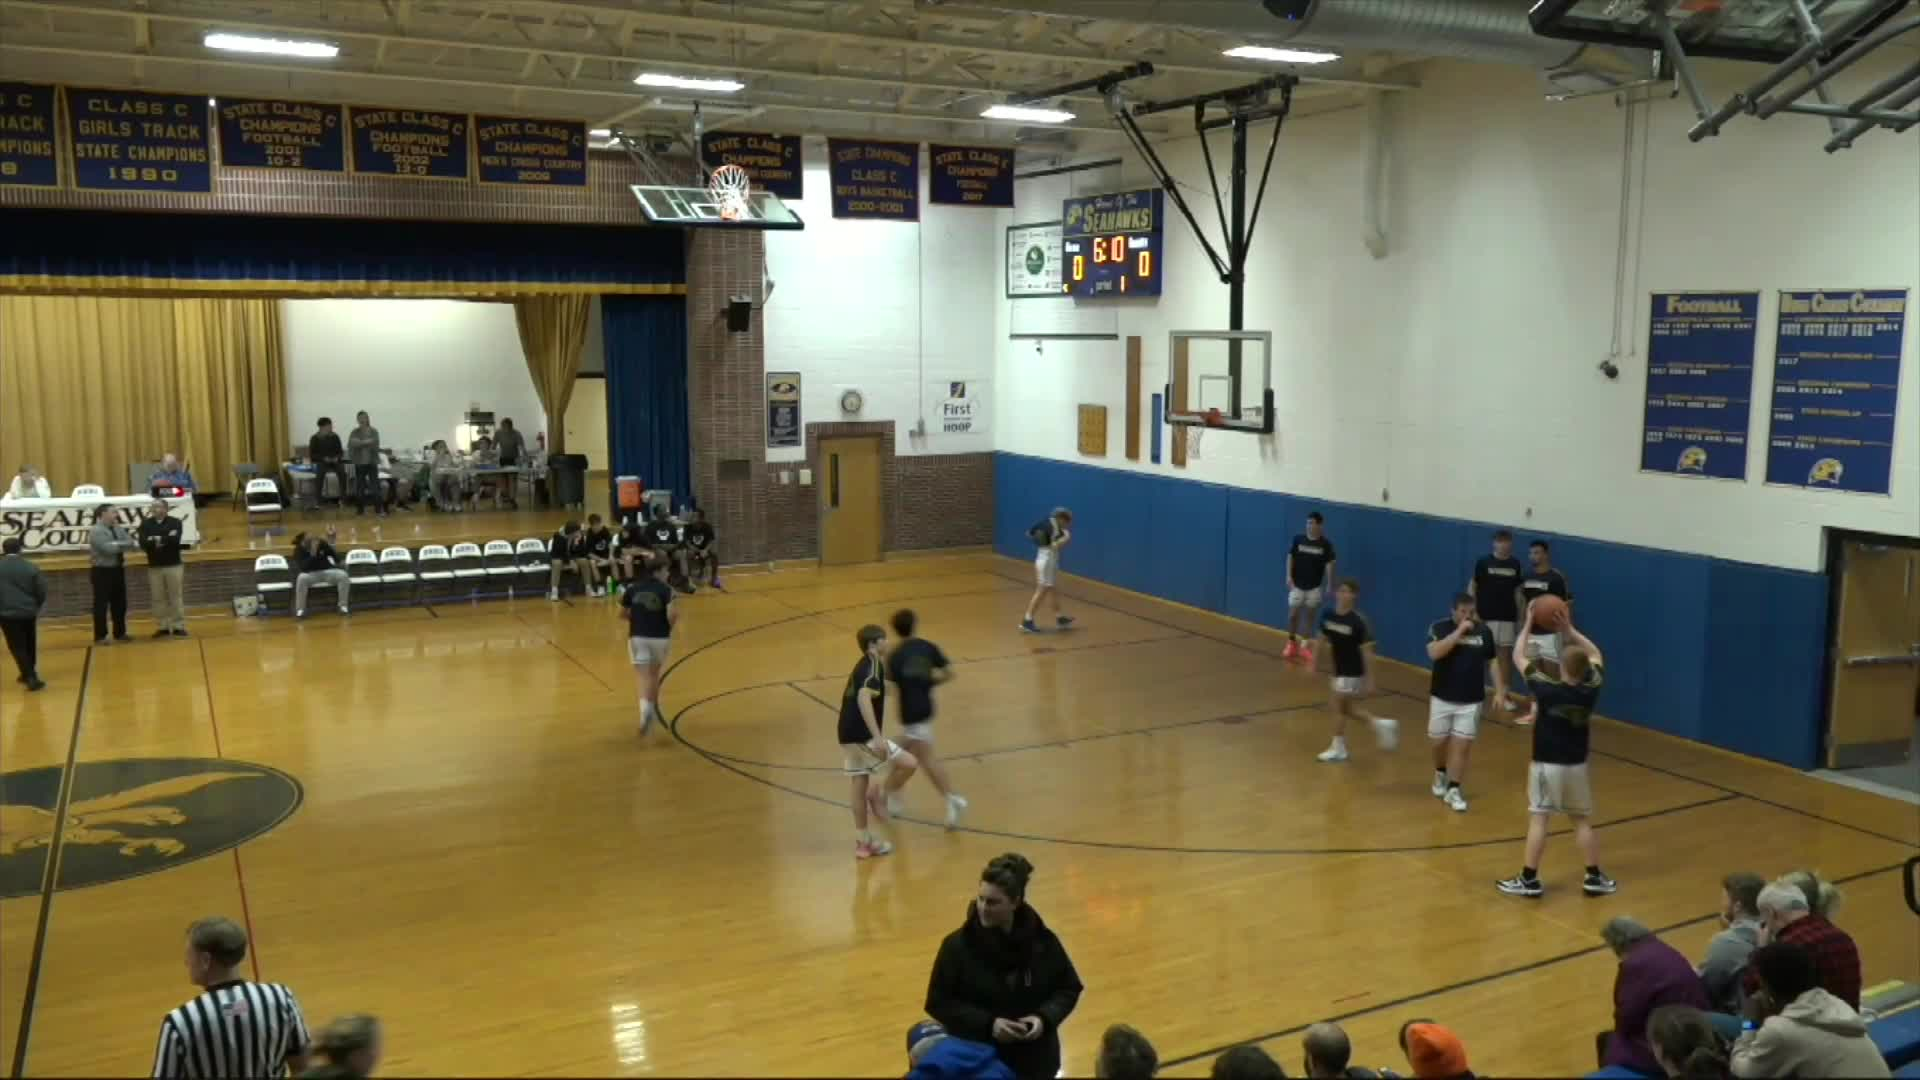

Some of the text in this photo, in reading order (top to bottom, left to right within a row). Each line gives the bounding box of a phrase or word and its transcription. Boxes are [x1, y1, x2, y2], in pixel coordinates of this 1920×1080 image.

[87, 98, 189, 117] CLASS C
[224, 102, 337, 127] STATE CLASS C
[79, 119, 201, 140] GIRLS TRACK
[239, 119, 322, 135] CHAMPIONS
[354, 111, 464, 136] STATE CLASS C
[241, 132, 321, 147] FOOTBALL
[369, 130, 448, 146] CHAMPIONS
[480, 123, 583, 146] STATE CLASS C
[76, 142, 209, 163] STATE CHAMPIONS
[372, 144, 448, 157] FOOTBALL
[495, 141, 569, 157] CHAMPIONS
[708, 137, 741, 153] STATE
[936, 151, 964, 166] STATE
[967, 151, 1000, 165] CLASS
[108, 166, 178, 182] 1990
[851, 168, 886, 182] CLASS
[947, 165, 999, 177] CHAMPIONS
[943, 402, 971, 415] First
[943, 422, 972, 432] HOOP
